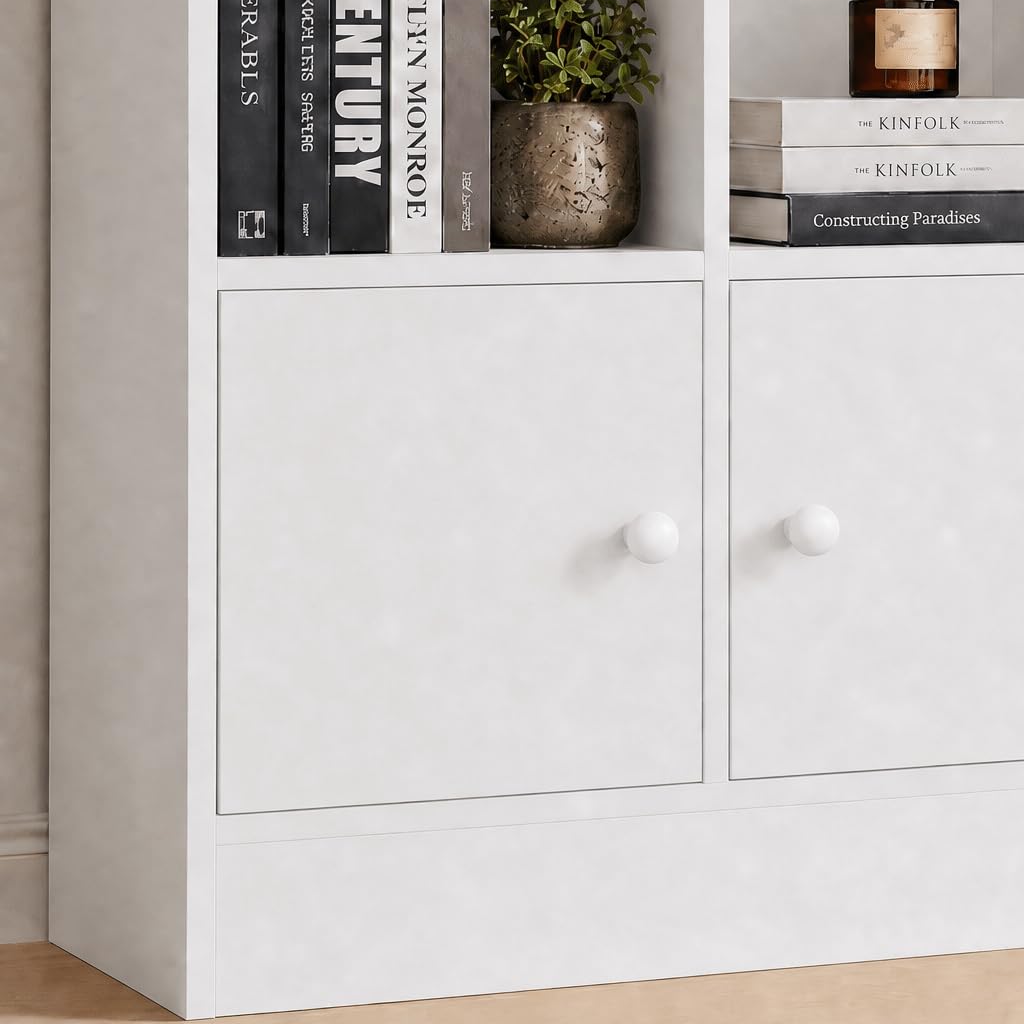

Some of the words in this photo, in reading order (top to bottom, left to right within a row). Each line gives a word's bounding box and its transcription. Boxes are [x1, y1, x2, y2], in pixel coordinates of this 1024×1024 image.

[879, 116, 961, 130] KINFOLK
[407, 80, 428, 220] MONROE
[875, 163, 957, 177] KINFOLK
[813, 212, 910, 230] Constructing
[913, 210, 982, 226] Paradises
